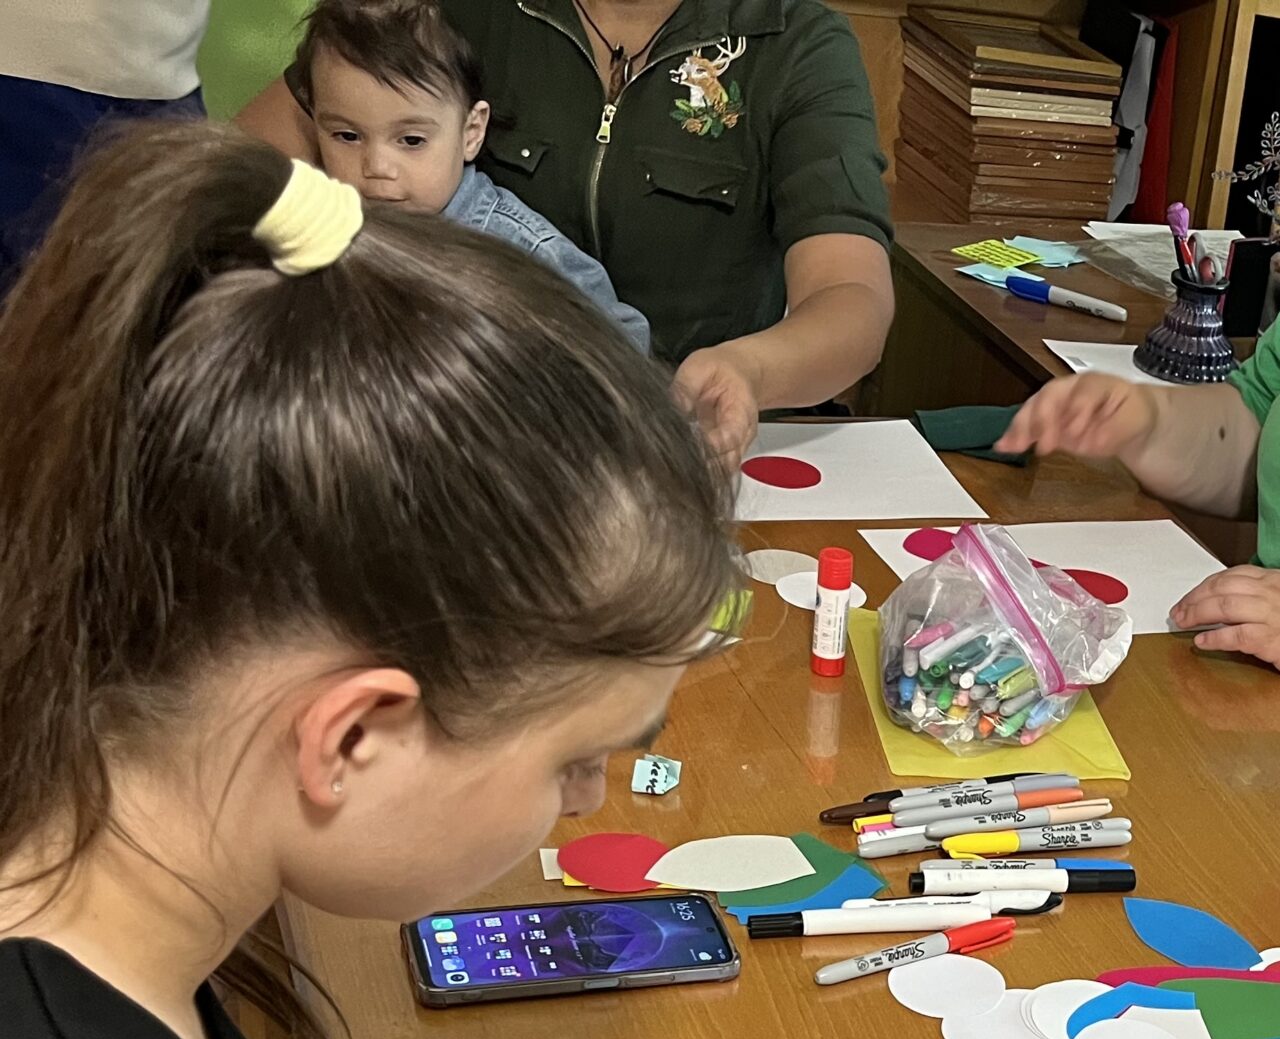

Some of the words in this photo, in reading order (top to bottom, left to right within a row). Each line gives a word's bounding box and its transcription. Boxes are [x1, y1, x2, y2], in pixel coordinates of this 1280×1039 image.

[955, 789, 993, 805] Sharpie
[1040, 833, 1079, 847] Sharpie
[882, 942, 926, 963] Sharpie
